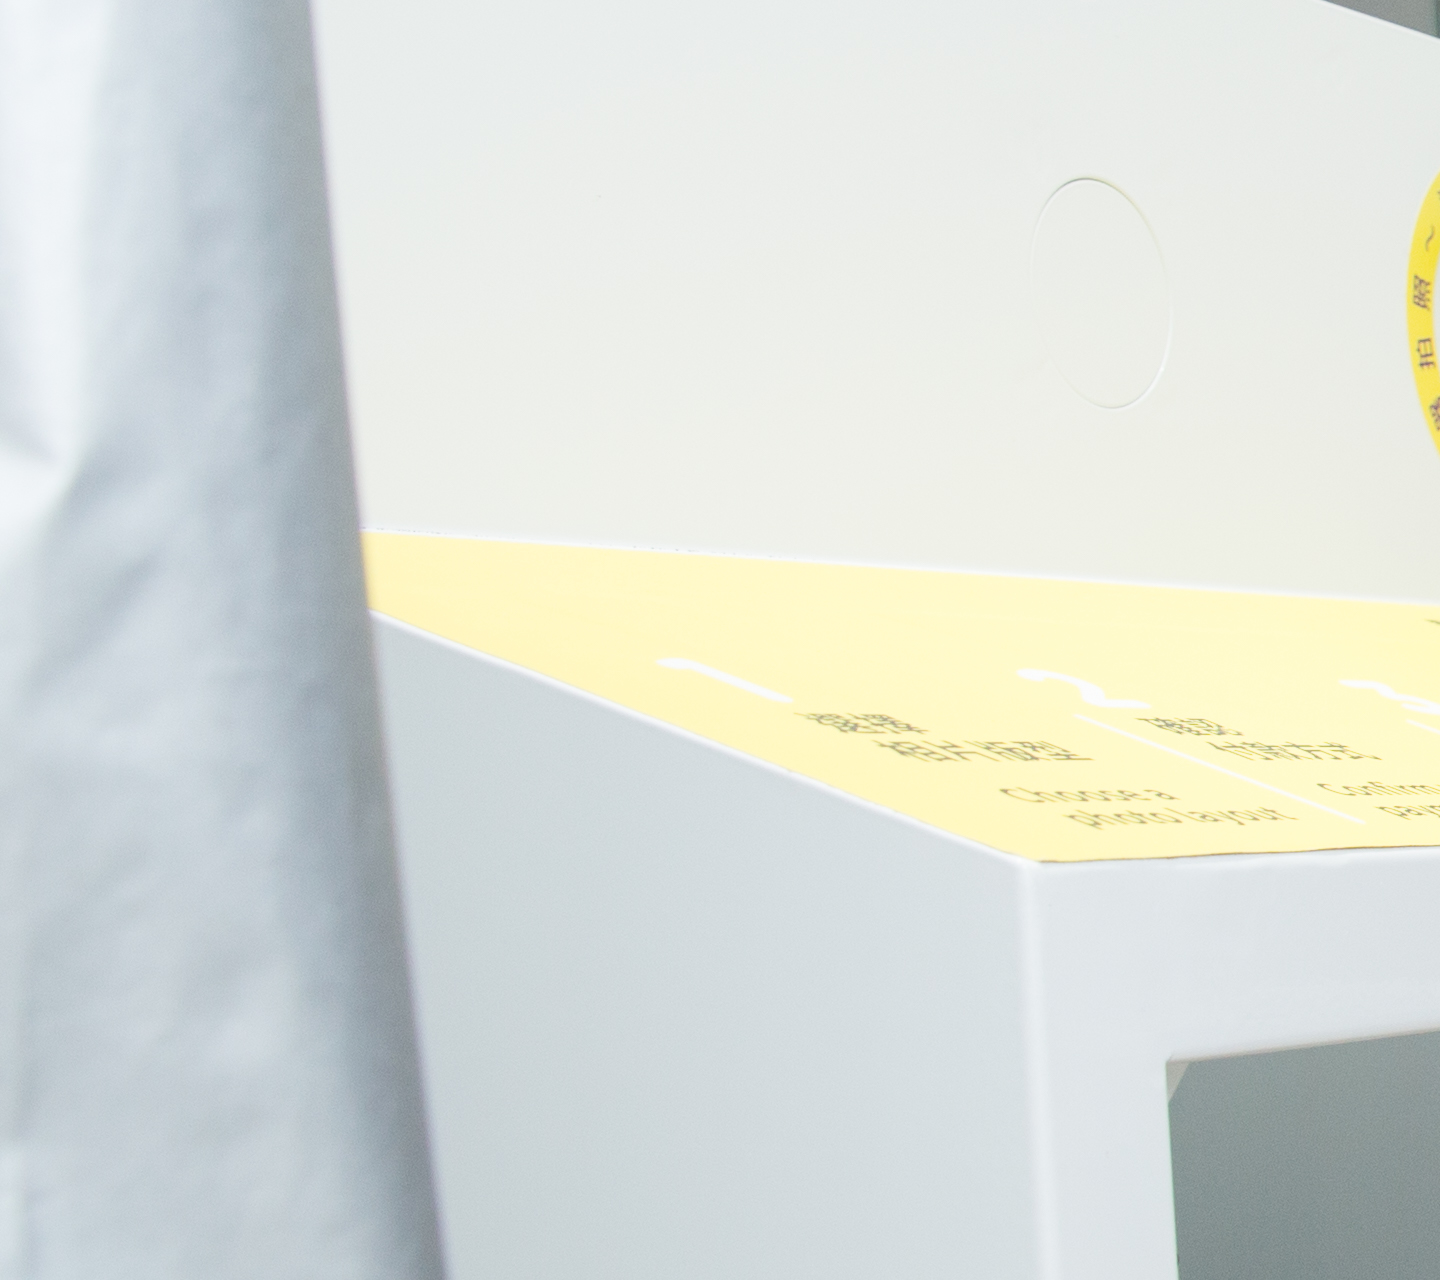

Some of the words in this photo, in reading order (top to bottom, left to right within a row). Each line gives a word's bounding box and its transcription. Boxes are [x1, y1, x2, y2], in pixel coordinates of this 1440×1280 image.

[656, 657, 793, 703] 1
[1016, 668, 1150, 709] 2
[795, 712, 929, 735] 選擇
[1136, 717, 1243, 737] 確認
[873, 740, 1093, 762] 相片版型
[1211, 741, 1382, 761] 付款方式
[1000, 787, 1145, 804] Choose
[1147, 790, 1179, 801] a
[1063, 808, 1184, 831] photo
[1179, 805, 1299, 826] layout
